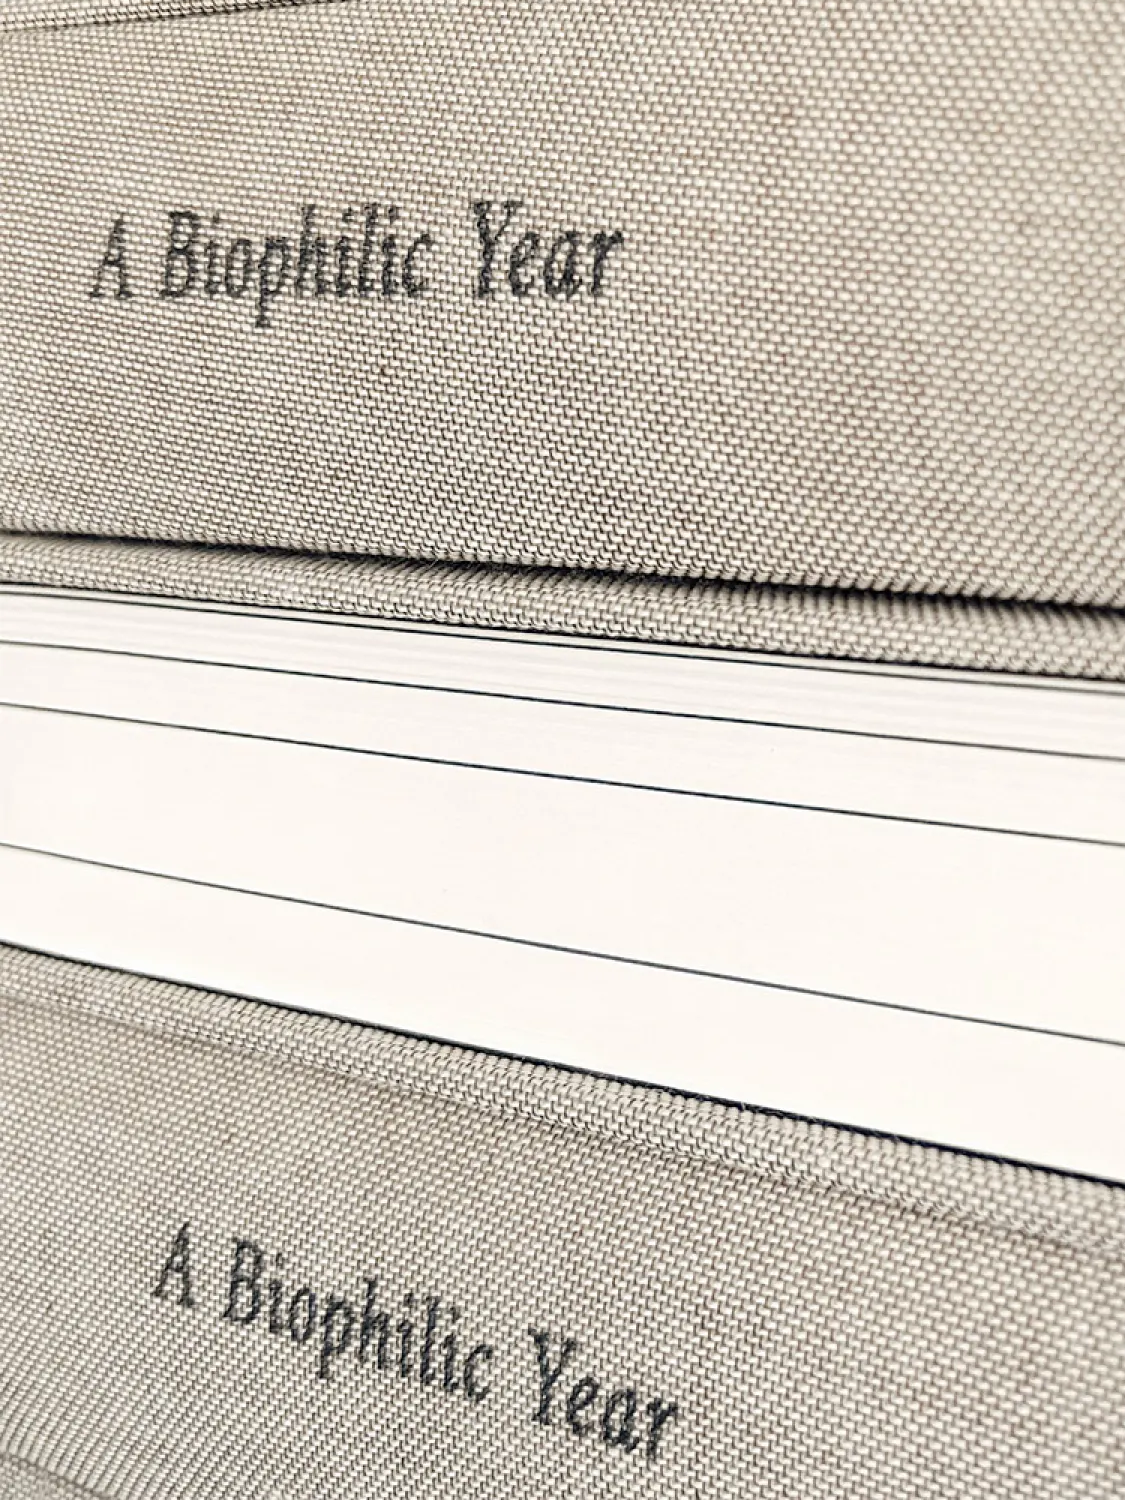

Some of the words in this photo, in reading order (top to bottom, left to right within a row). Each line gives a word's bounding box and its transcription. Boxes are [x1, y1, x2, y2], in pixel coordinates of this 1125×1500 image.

[87, 216, 135, 302] A
[158, 200, 436, 330] Biophilic
[468, 198, 627, 300] Year
[150, 1220, 198, 1311] A
[220, 1235, 496, 1406] Biophilic
[526, 1326, 683, 1464] Year
